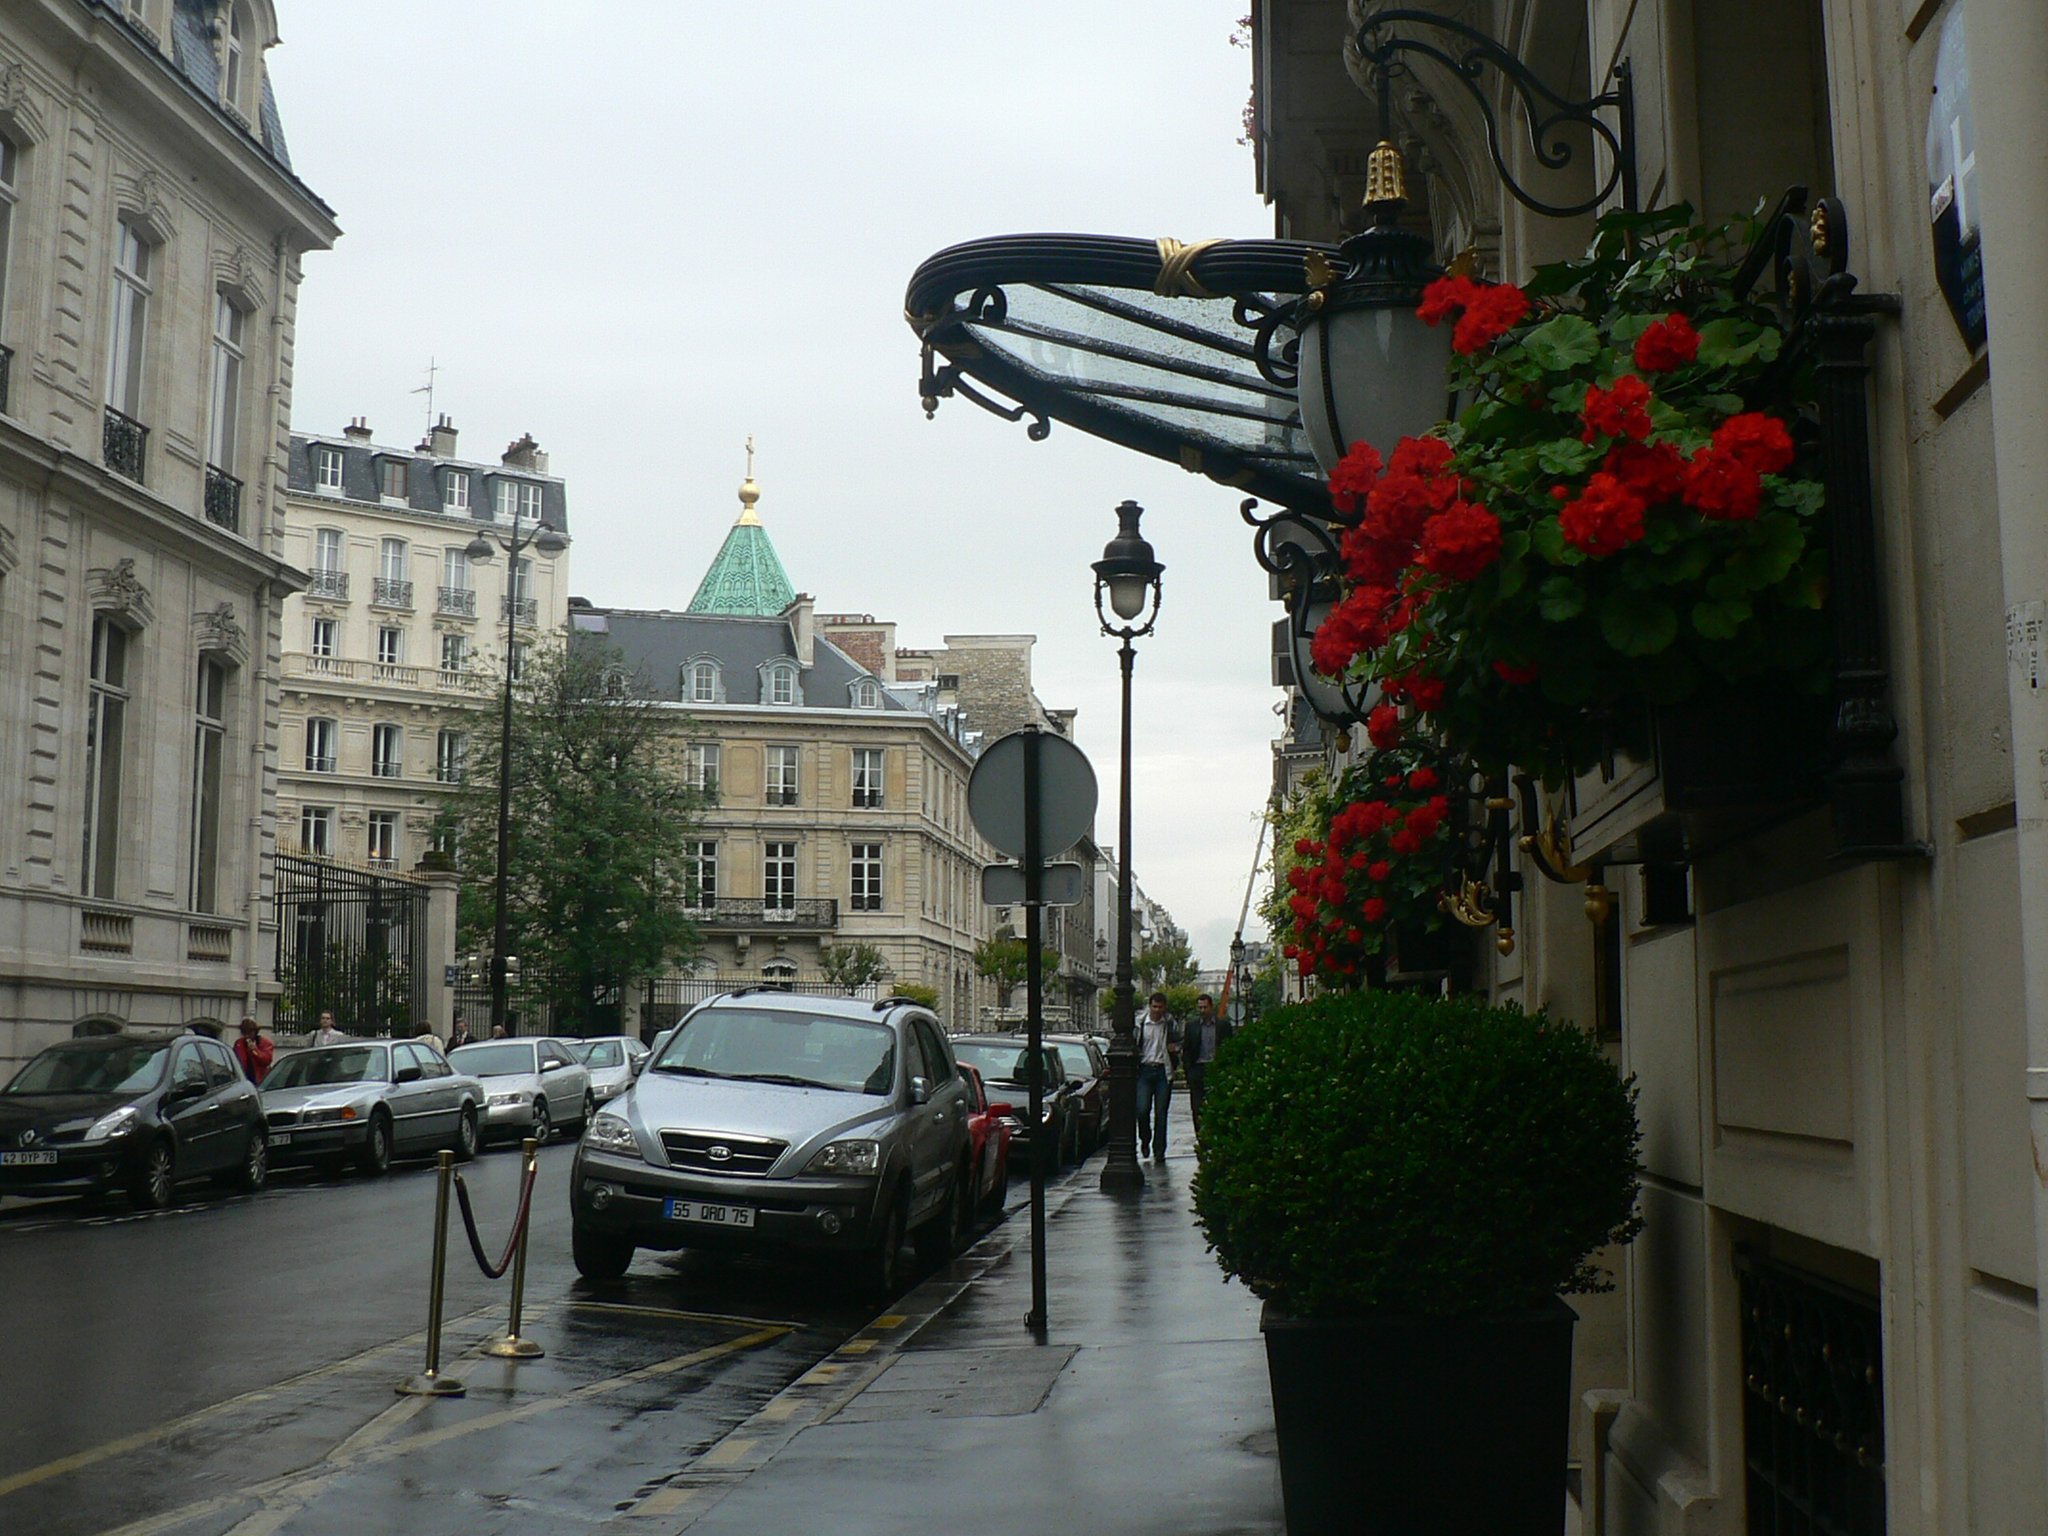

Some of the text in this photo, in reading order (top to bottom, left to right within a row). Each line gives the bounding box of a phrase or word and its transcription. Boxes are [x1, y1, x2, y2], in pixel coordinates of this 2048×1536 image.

[4, 1153, 16, 1164] 42
[43, 1152, 55, 1163] 78
[673, 1203, 690, 1218] 55
[732, 1209, 748, 1224] 75
